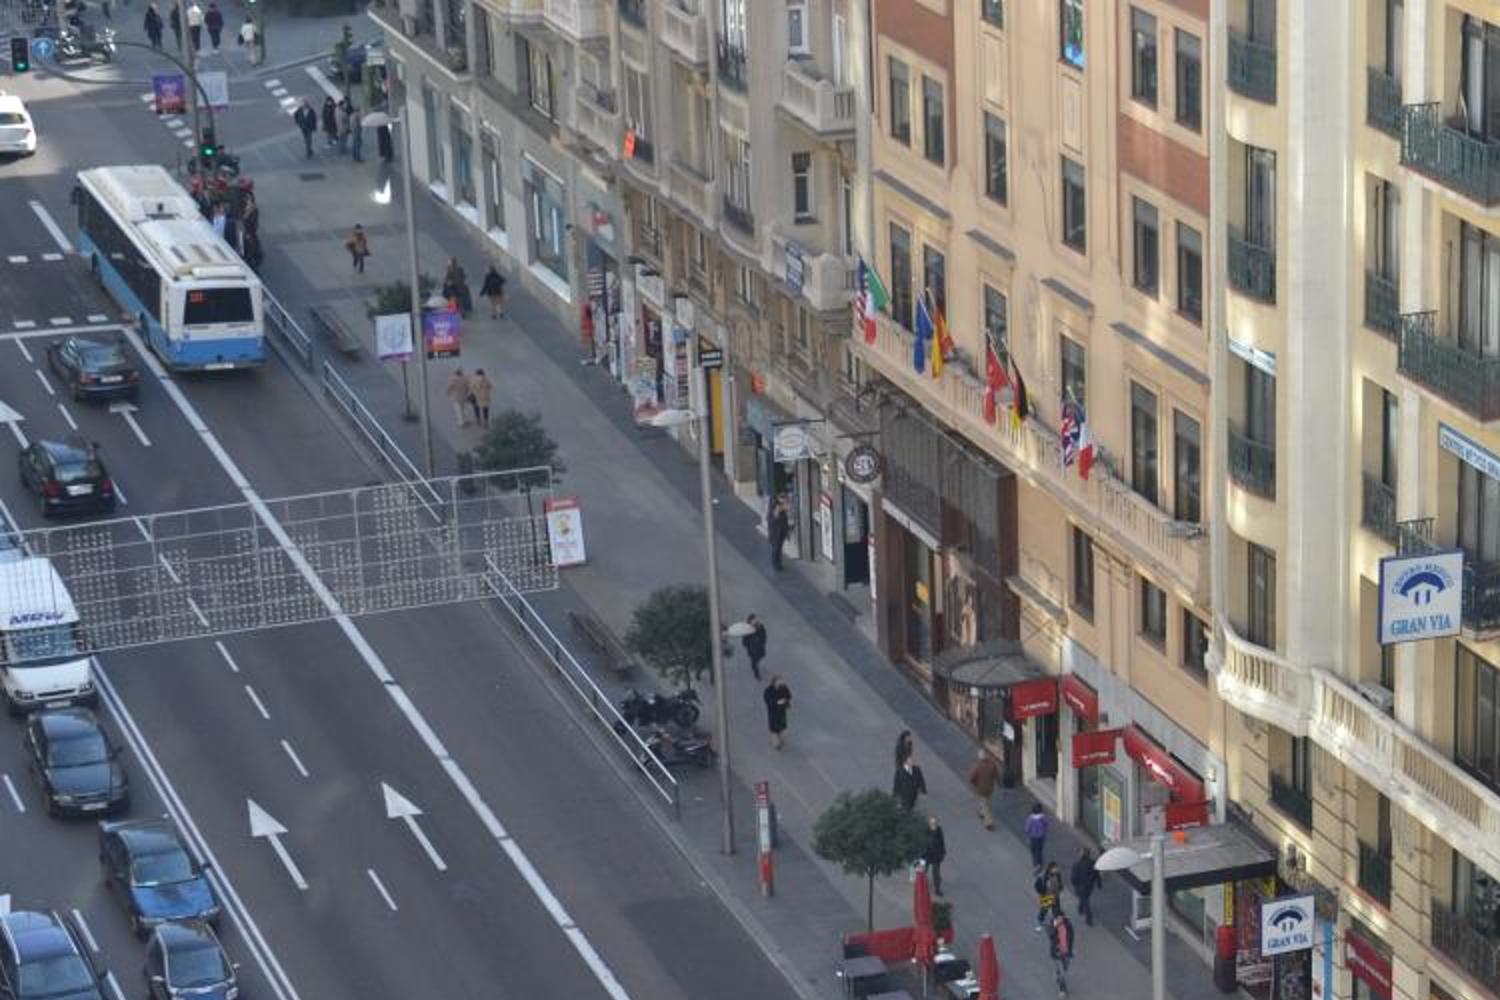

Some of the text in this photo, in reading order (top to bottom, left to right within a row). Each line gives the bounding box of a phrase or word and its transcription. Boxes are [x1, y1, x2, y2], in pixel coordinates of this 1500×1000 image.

[1391, 613, 1451, 635] GRAN VIA
[1267, 930, 1309, 948] GRAN VIA
